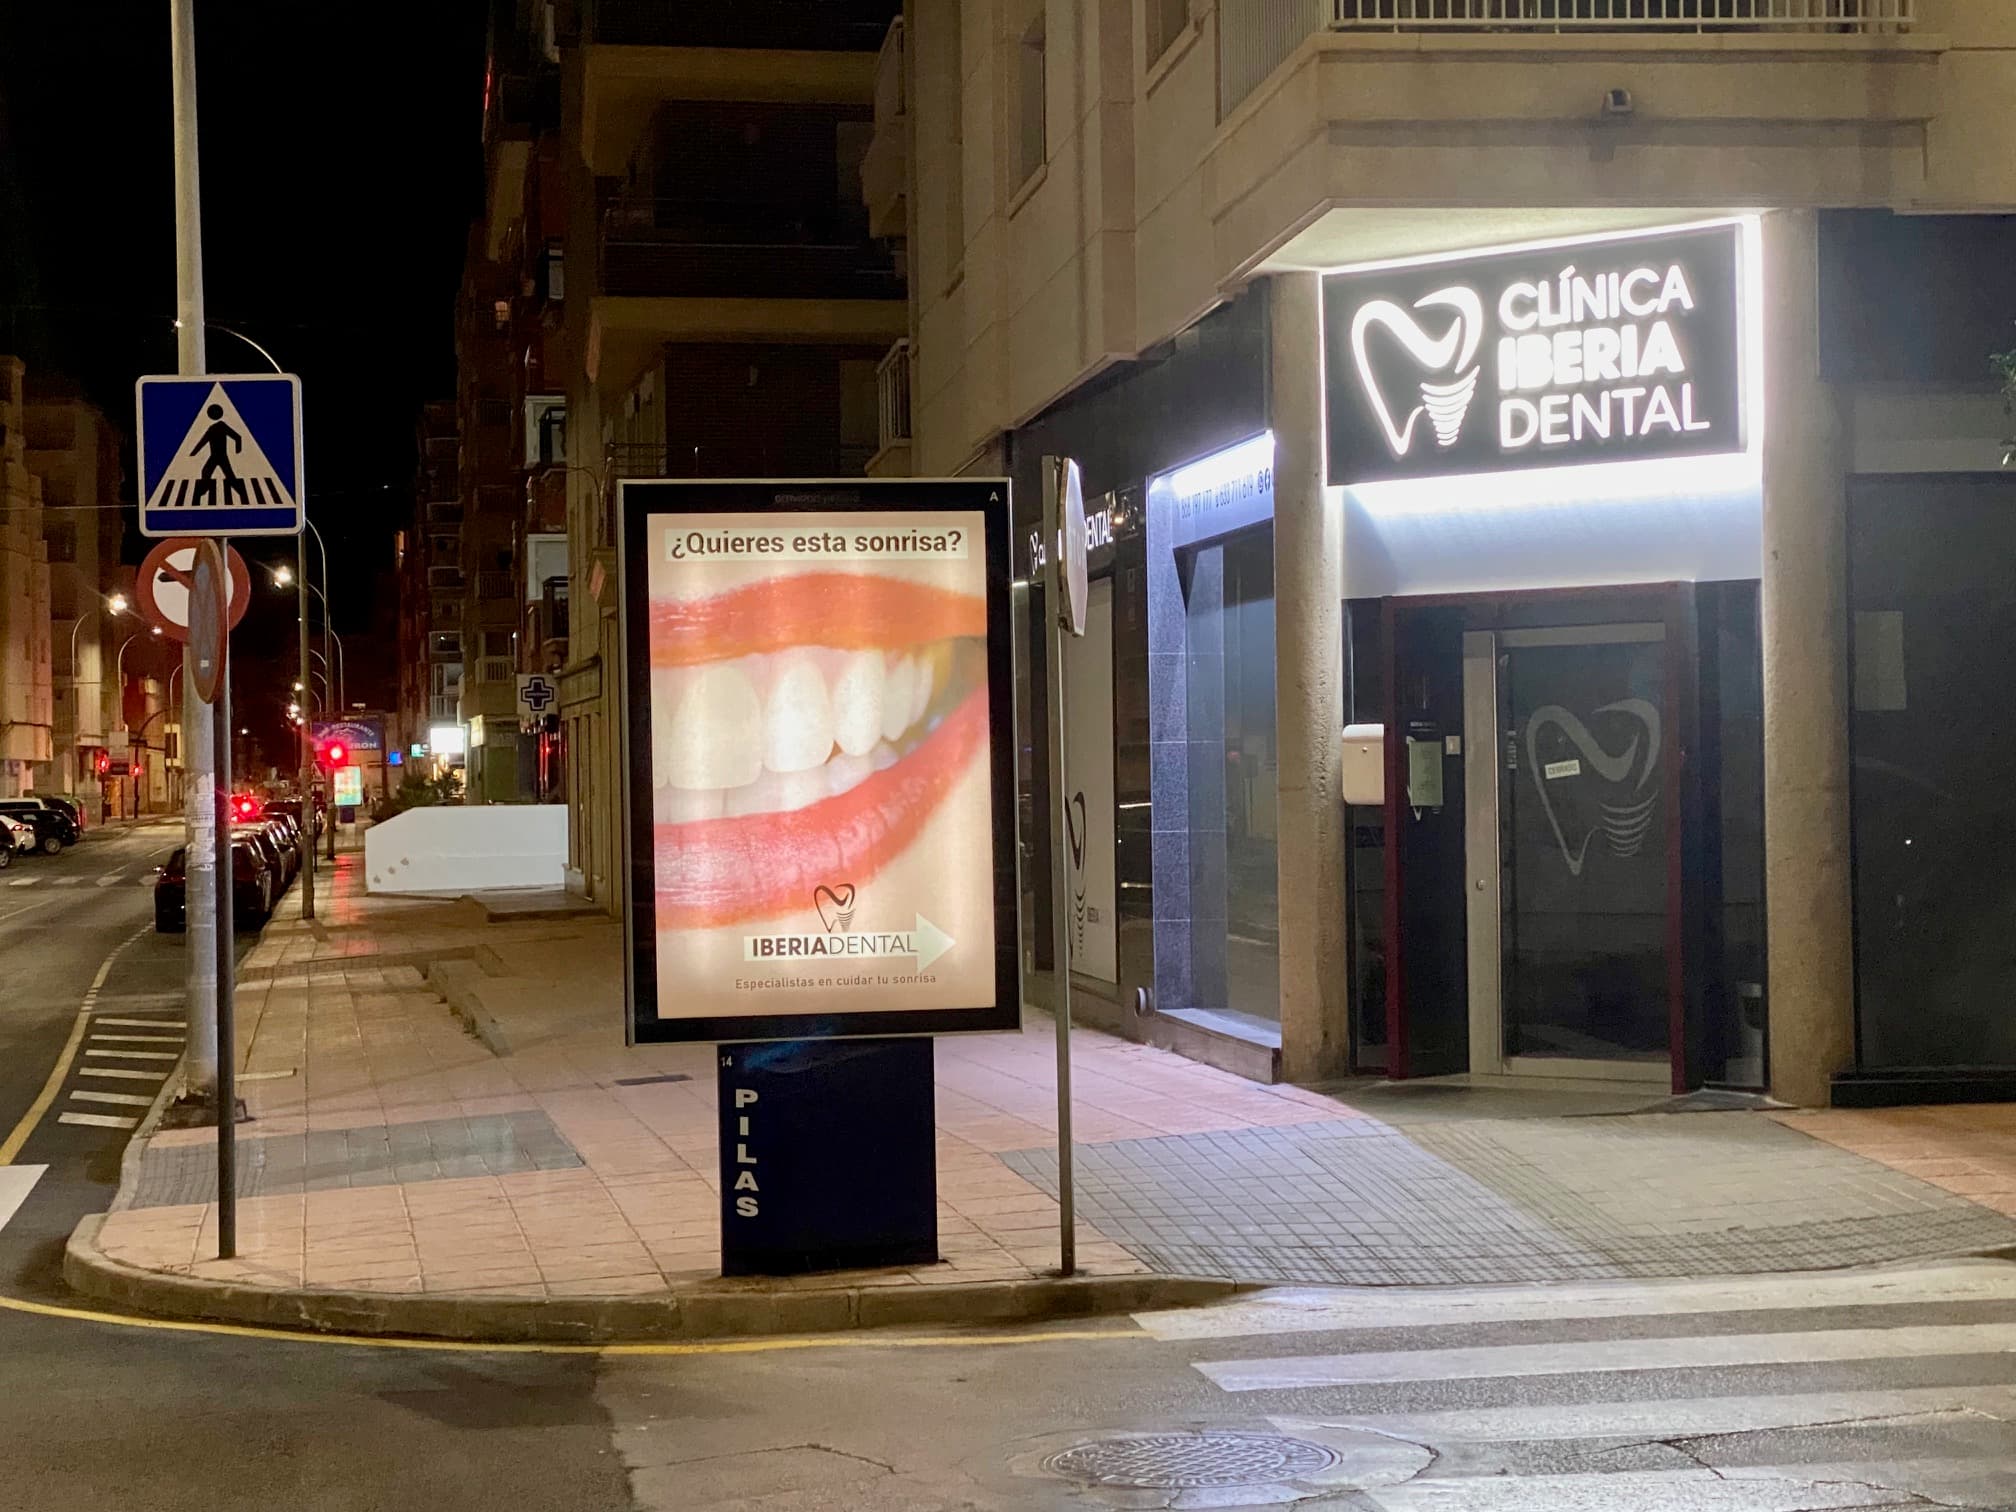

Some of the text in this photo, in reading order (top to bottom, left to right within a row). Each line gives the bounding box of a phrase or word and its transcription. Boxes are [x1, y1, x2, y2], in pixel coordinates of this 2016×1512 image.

[1499, 264, 1694, 331] CLÍNICA
[1498, 321, 1685, 390] IBERIA
[1500, 383, 1711, 447] DENTAL
[989, 491, 999, 501] A
[671, 529, 962, 559] ¿Quieres esta sonrisa?
[752, 934, 919, 957] IBERIADENTAL
[736, 974, 937, 991] Especialistas en cuidar tu sonrisa
[721, 1055, 733, 1067] 14
[734, 1088, 760, 1217] PILAS
